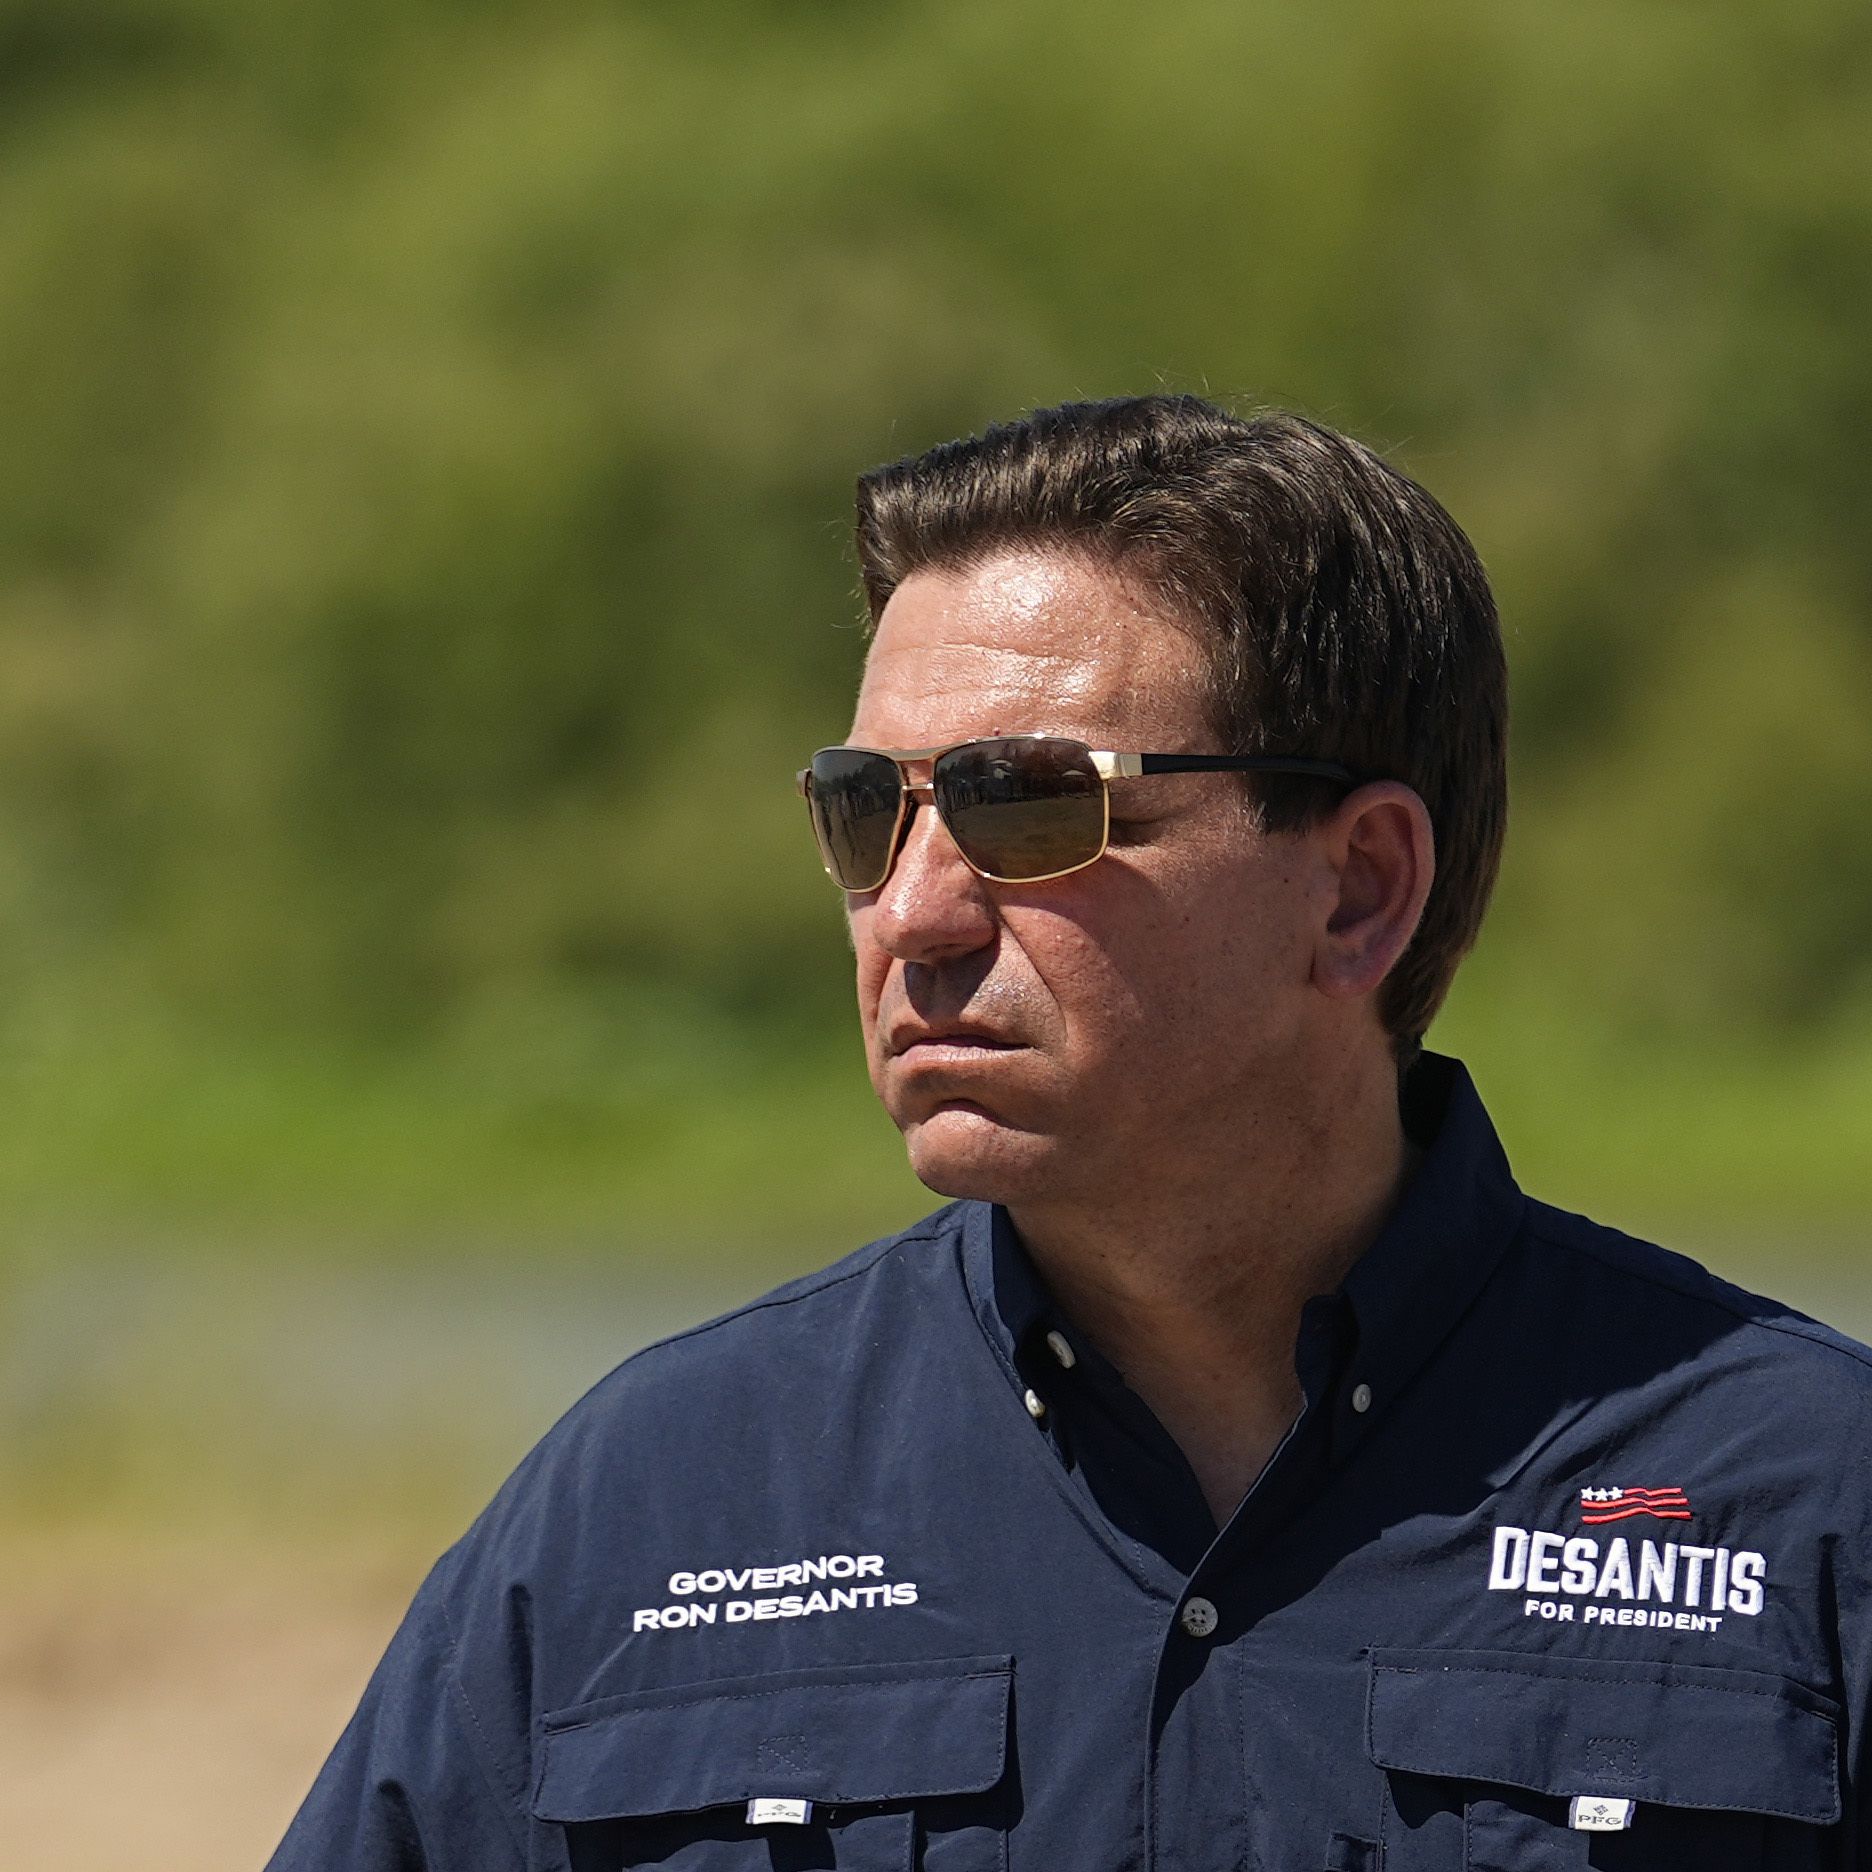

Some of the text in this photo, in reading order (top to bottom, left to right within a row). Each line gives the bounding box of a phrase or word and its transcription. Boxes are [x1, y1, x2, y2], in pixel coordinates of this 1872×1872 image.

[668, 1554, 885, 1595] GOVERNOR
[1488, 1525, 1767, 1617] DESANTIS
[632, 1582, 919, 1633] RON DESANTIS
[1524, 1599, 1724, 1633] FOR PRESIDENT
[1577, 1814, 1622, 1826] PFG
